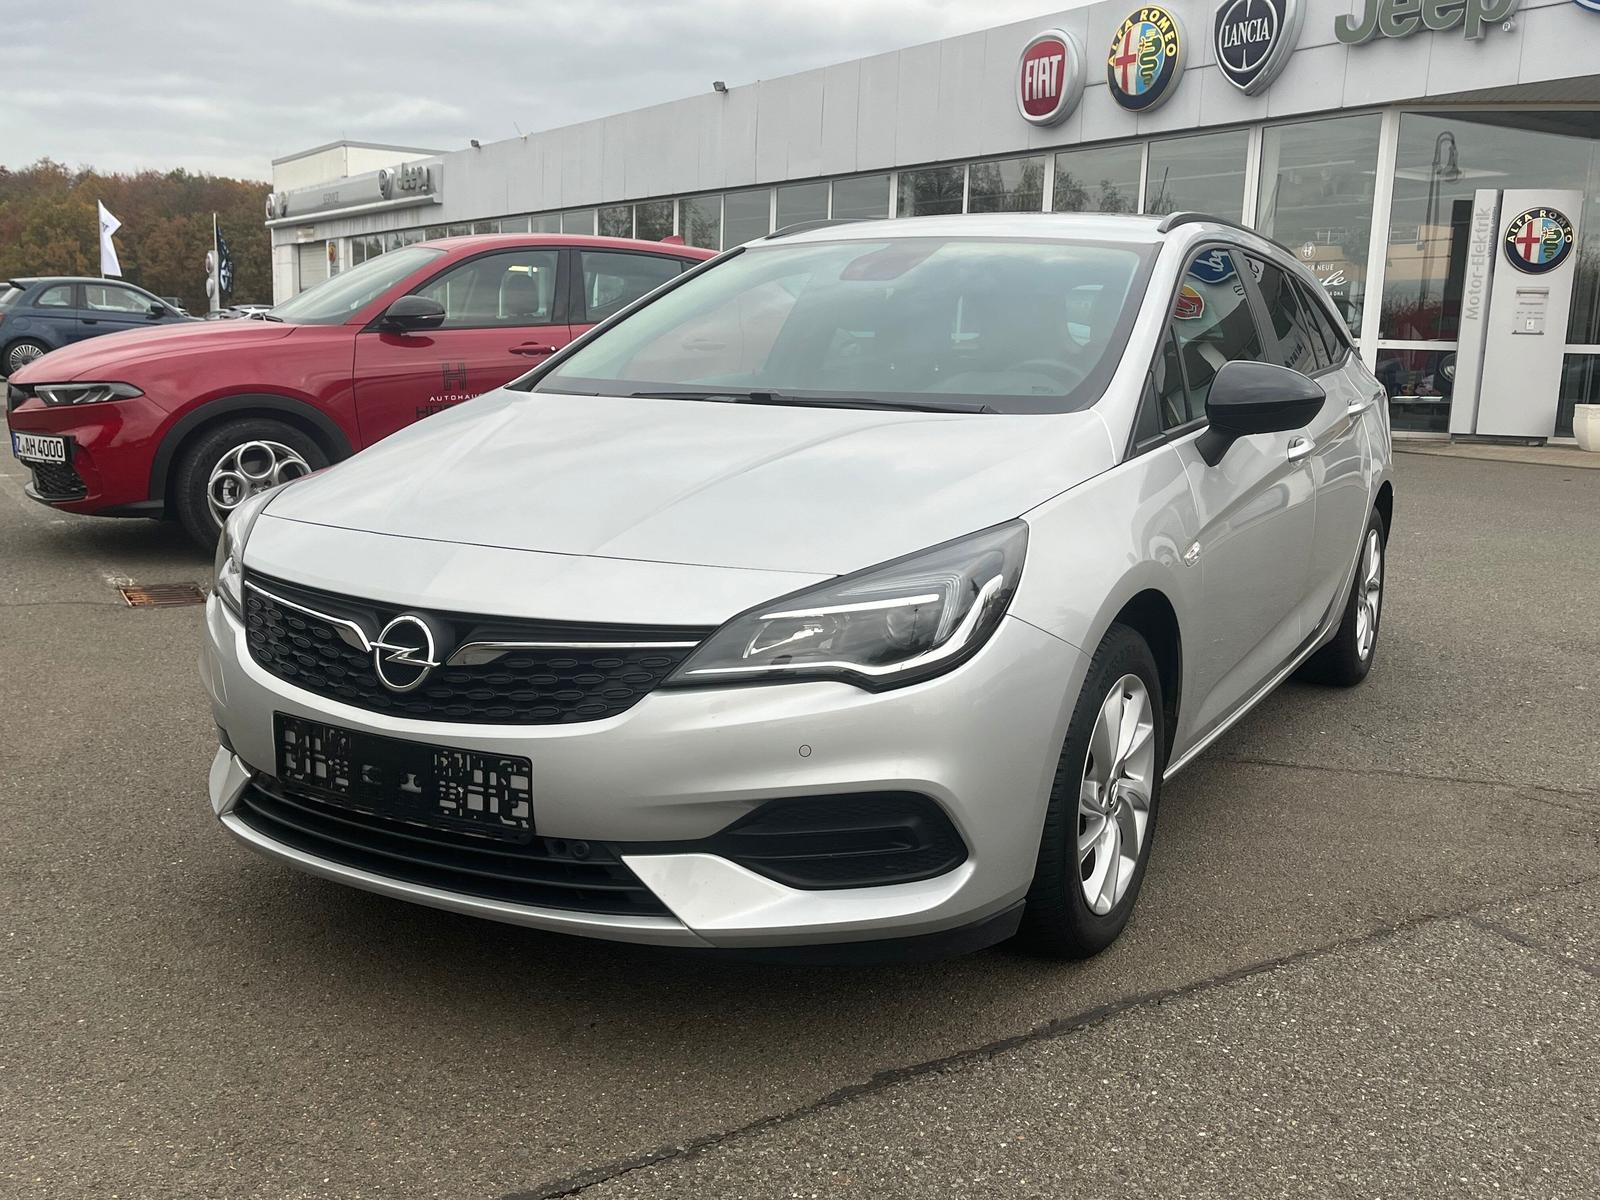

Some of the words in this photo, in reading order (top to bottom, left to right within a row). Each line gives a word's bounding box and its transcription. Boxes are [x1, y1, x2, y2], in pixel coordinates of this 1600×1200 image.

[1108, 20, 1134, 67] ALFA
[1139, 9, 1177, 57] ROMEO
[1223, 17, 1271, 48] LANCIA
[1024, 54, 1062, 102] FIAT
[1507, 213, 1533, 243] ALFA
[1539, 210, 1573, 243] ROMEO
[1317, 263, 1334, 271] NEUE
[1465, 208, 1491, 320] Motor-Elektrik
[16, 435, 22, 453] Z
[25, 437, 37, 456] AH
[38, 439, 63, 459] 4000
